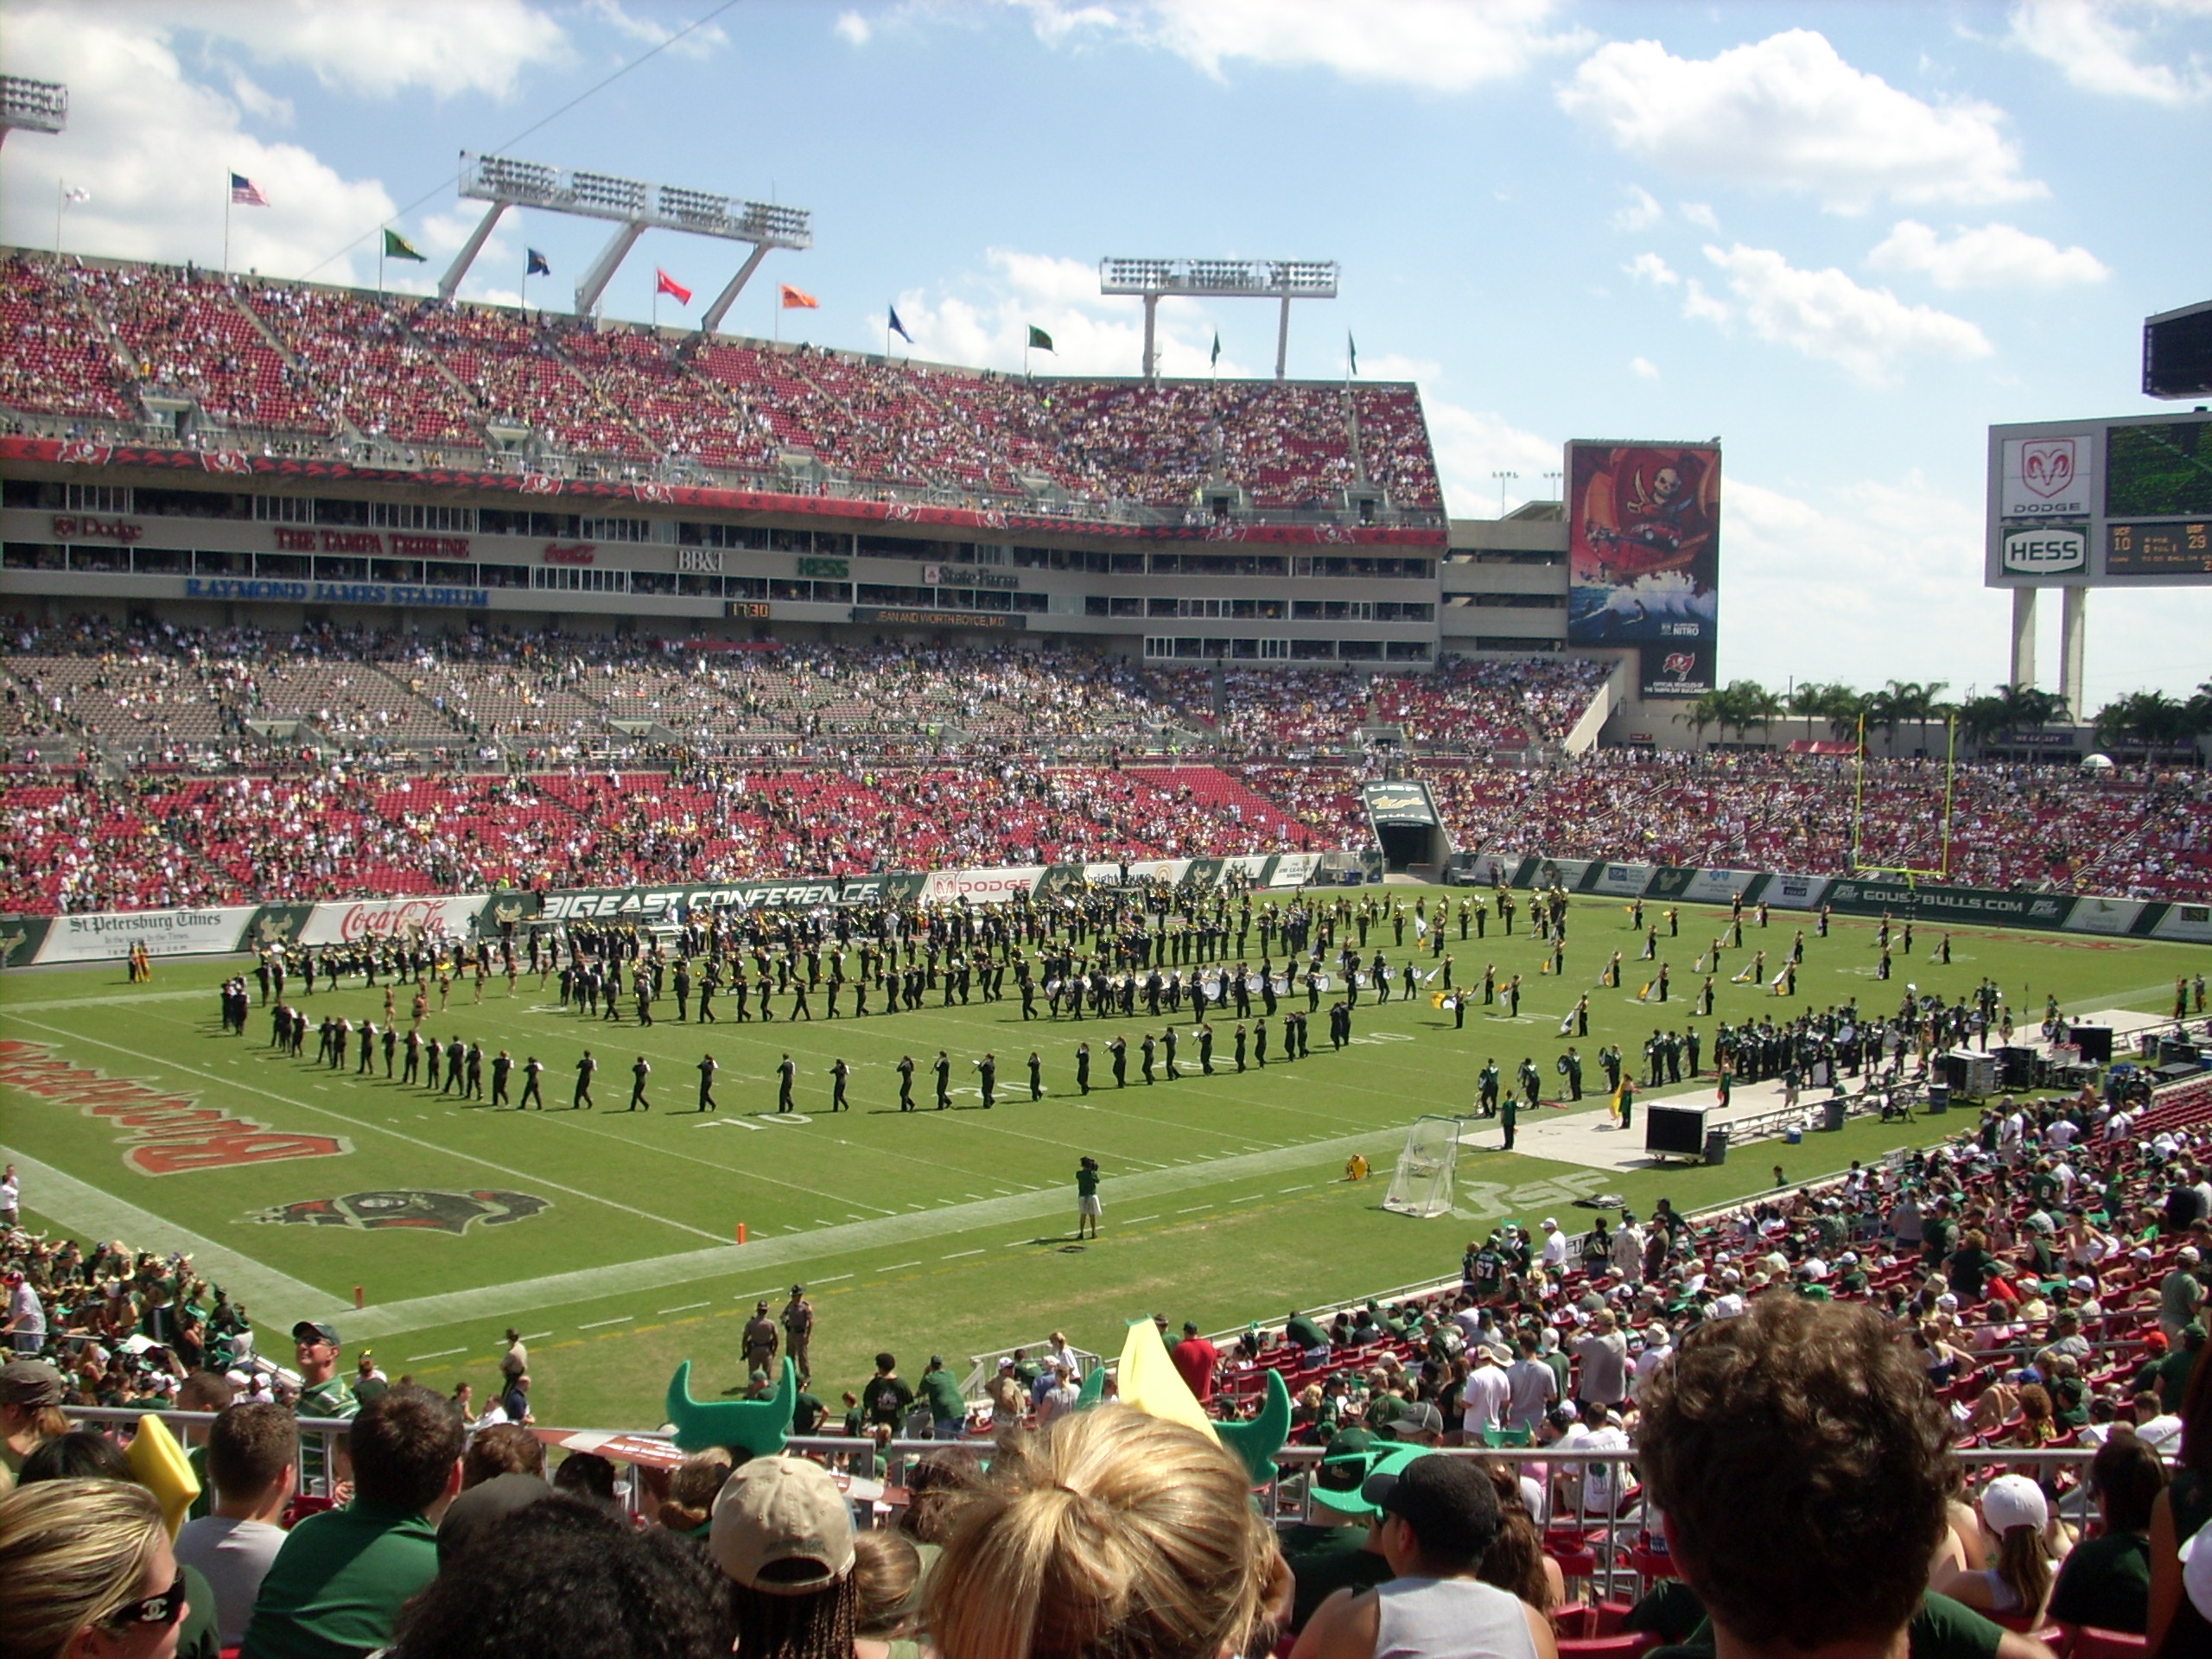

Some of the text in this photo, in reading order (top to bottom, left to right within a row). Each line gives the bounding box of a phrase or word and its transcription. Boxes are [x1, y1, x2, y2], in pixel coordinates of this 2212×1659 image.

[2013, 503, 2081, 513] DODGE
[83, 516, 143, 543] Dodge
[274, 527, 470, 559] THE TAMPA TRIBUNE
[2011, 541, 2078, 561] HESS
[2114, 537, 2131, 550] 10
[2188, 535, 2207, 549] 29
[678, 550, 726, 572] BB&T
[798, 556, 849, 578] HESS
[186, 577, 489, 607] RAYMOND JAMES STADIUM
[876, 611, 899, 623] JEAN
[899, 613, 918, 623] AND
[920, 613, 955, 625] WORTH
[958, 879, 1031, 893] DODGE
[543, 883, 880, 918] BIG EAST CONFERENCE
[93, 914, 173, 935] Petersburg
[176, 912, 221, 927] Times
[1476, 1260, 1494, 1279] 67
